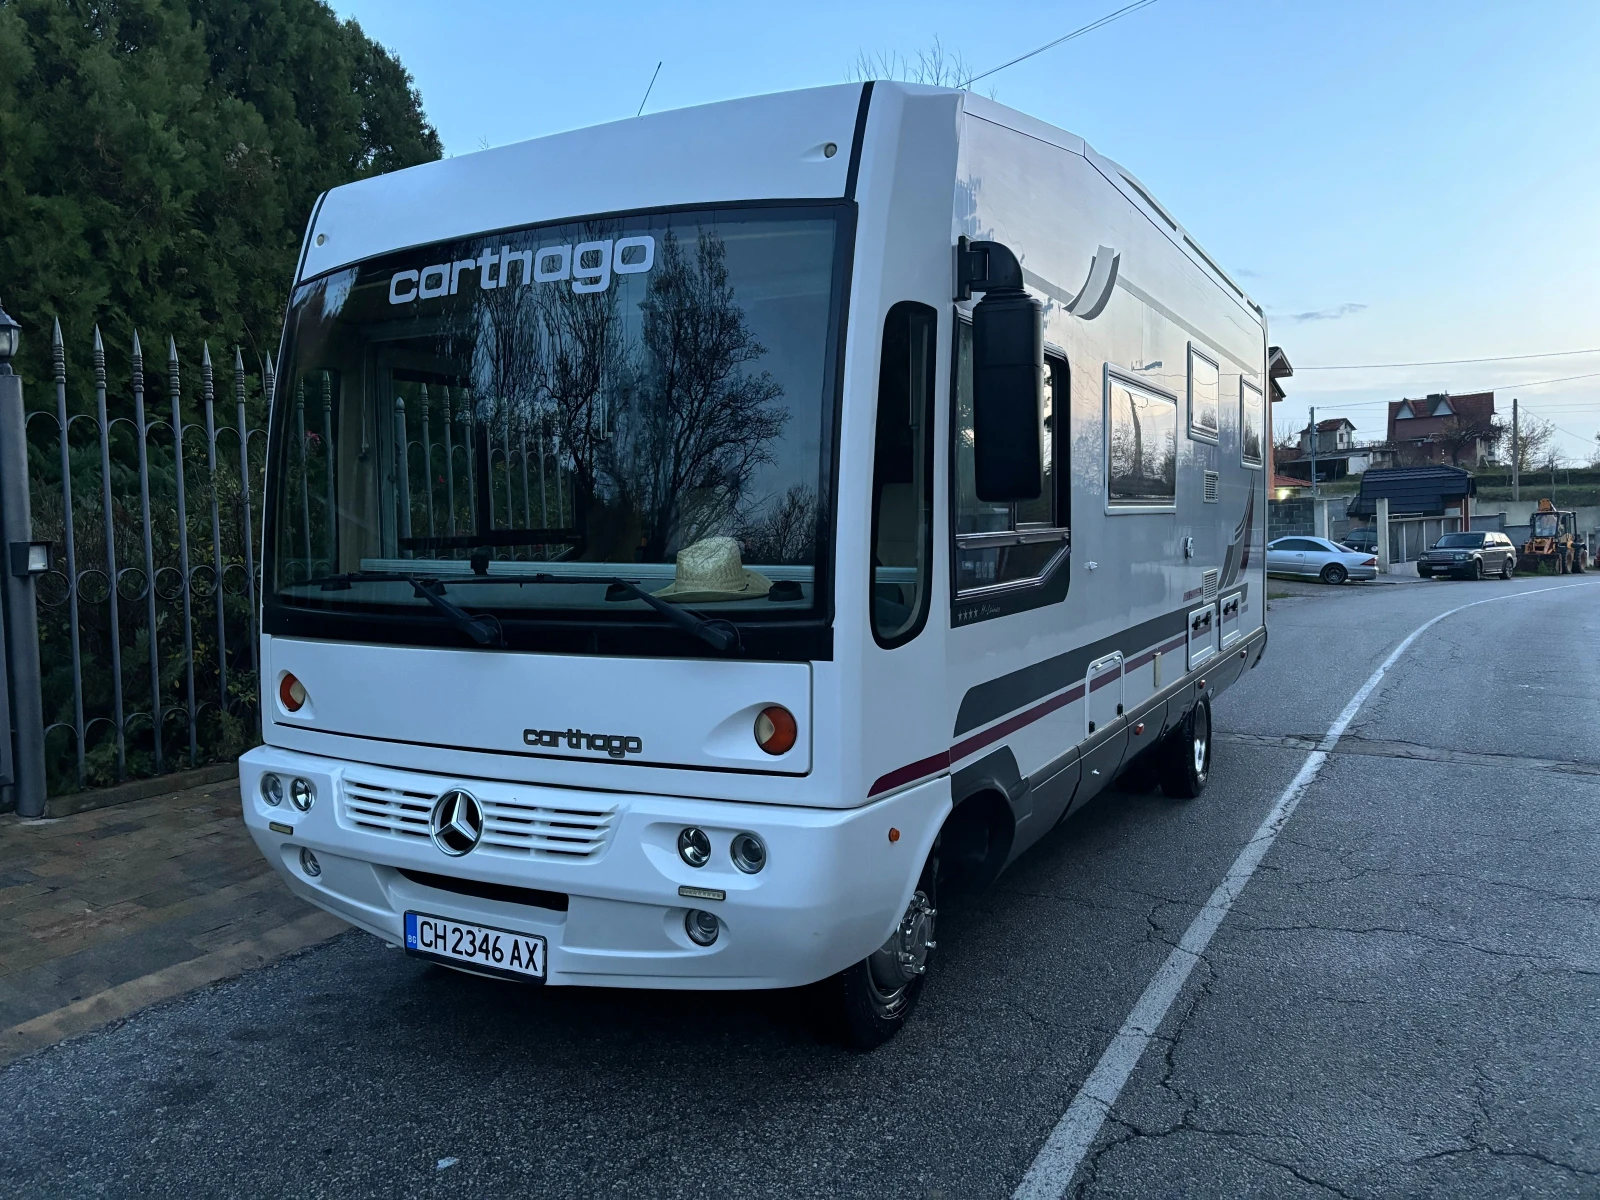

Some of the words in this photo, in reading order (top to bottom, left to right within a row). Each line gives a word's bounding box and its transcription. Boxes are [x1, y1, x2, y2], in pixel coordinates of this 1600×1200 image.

[388, 235, 656, 305] carthago
[523, 728, 643, 759] carthago
[407, 934, 417, 944] BG
[509, 938, 539, 972] AX
